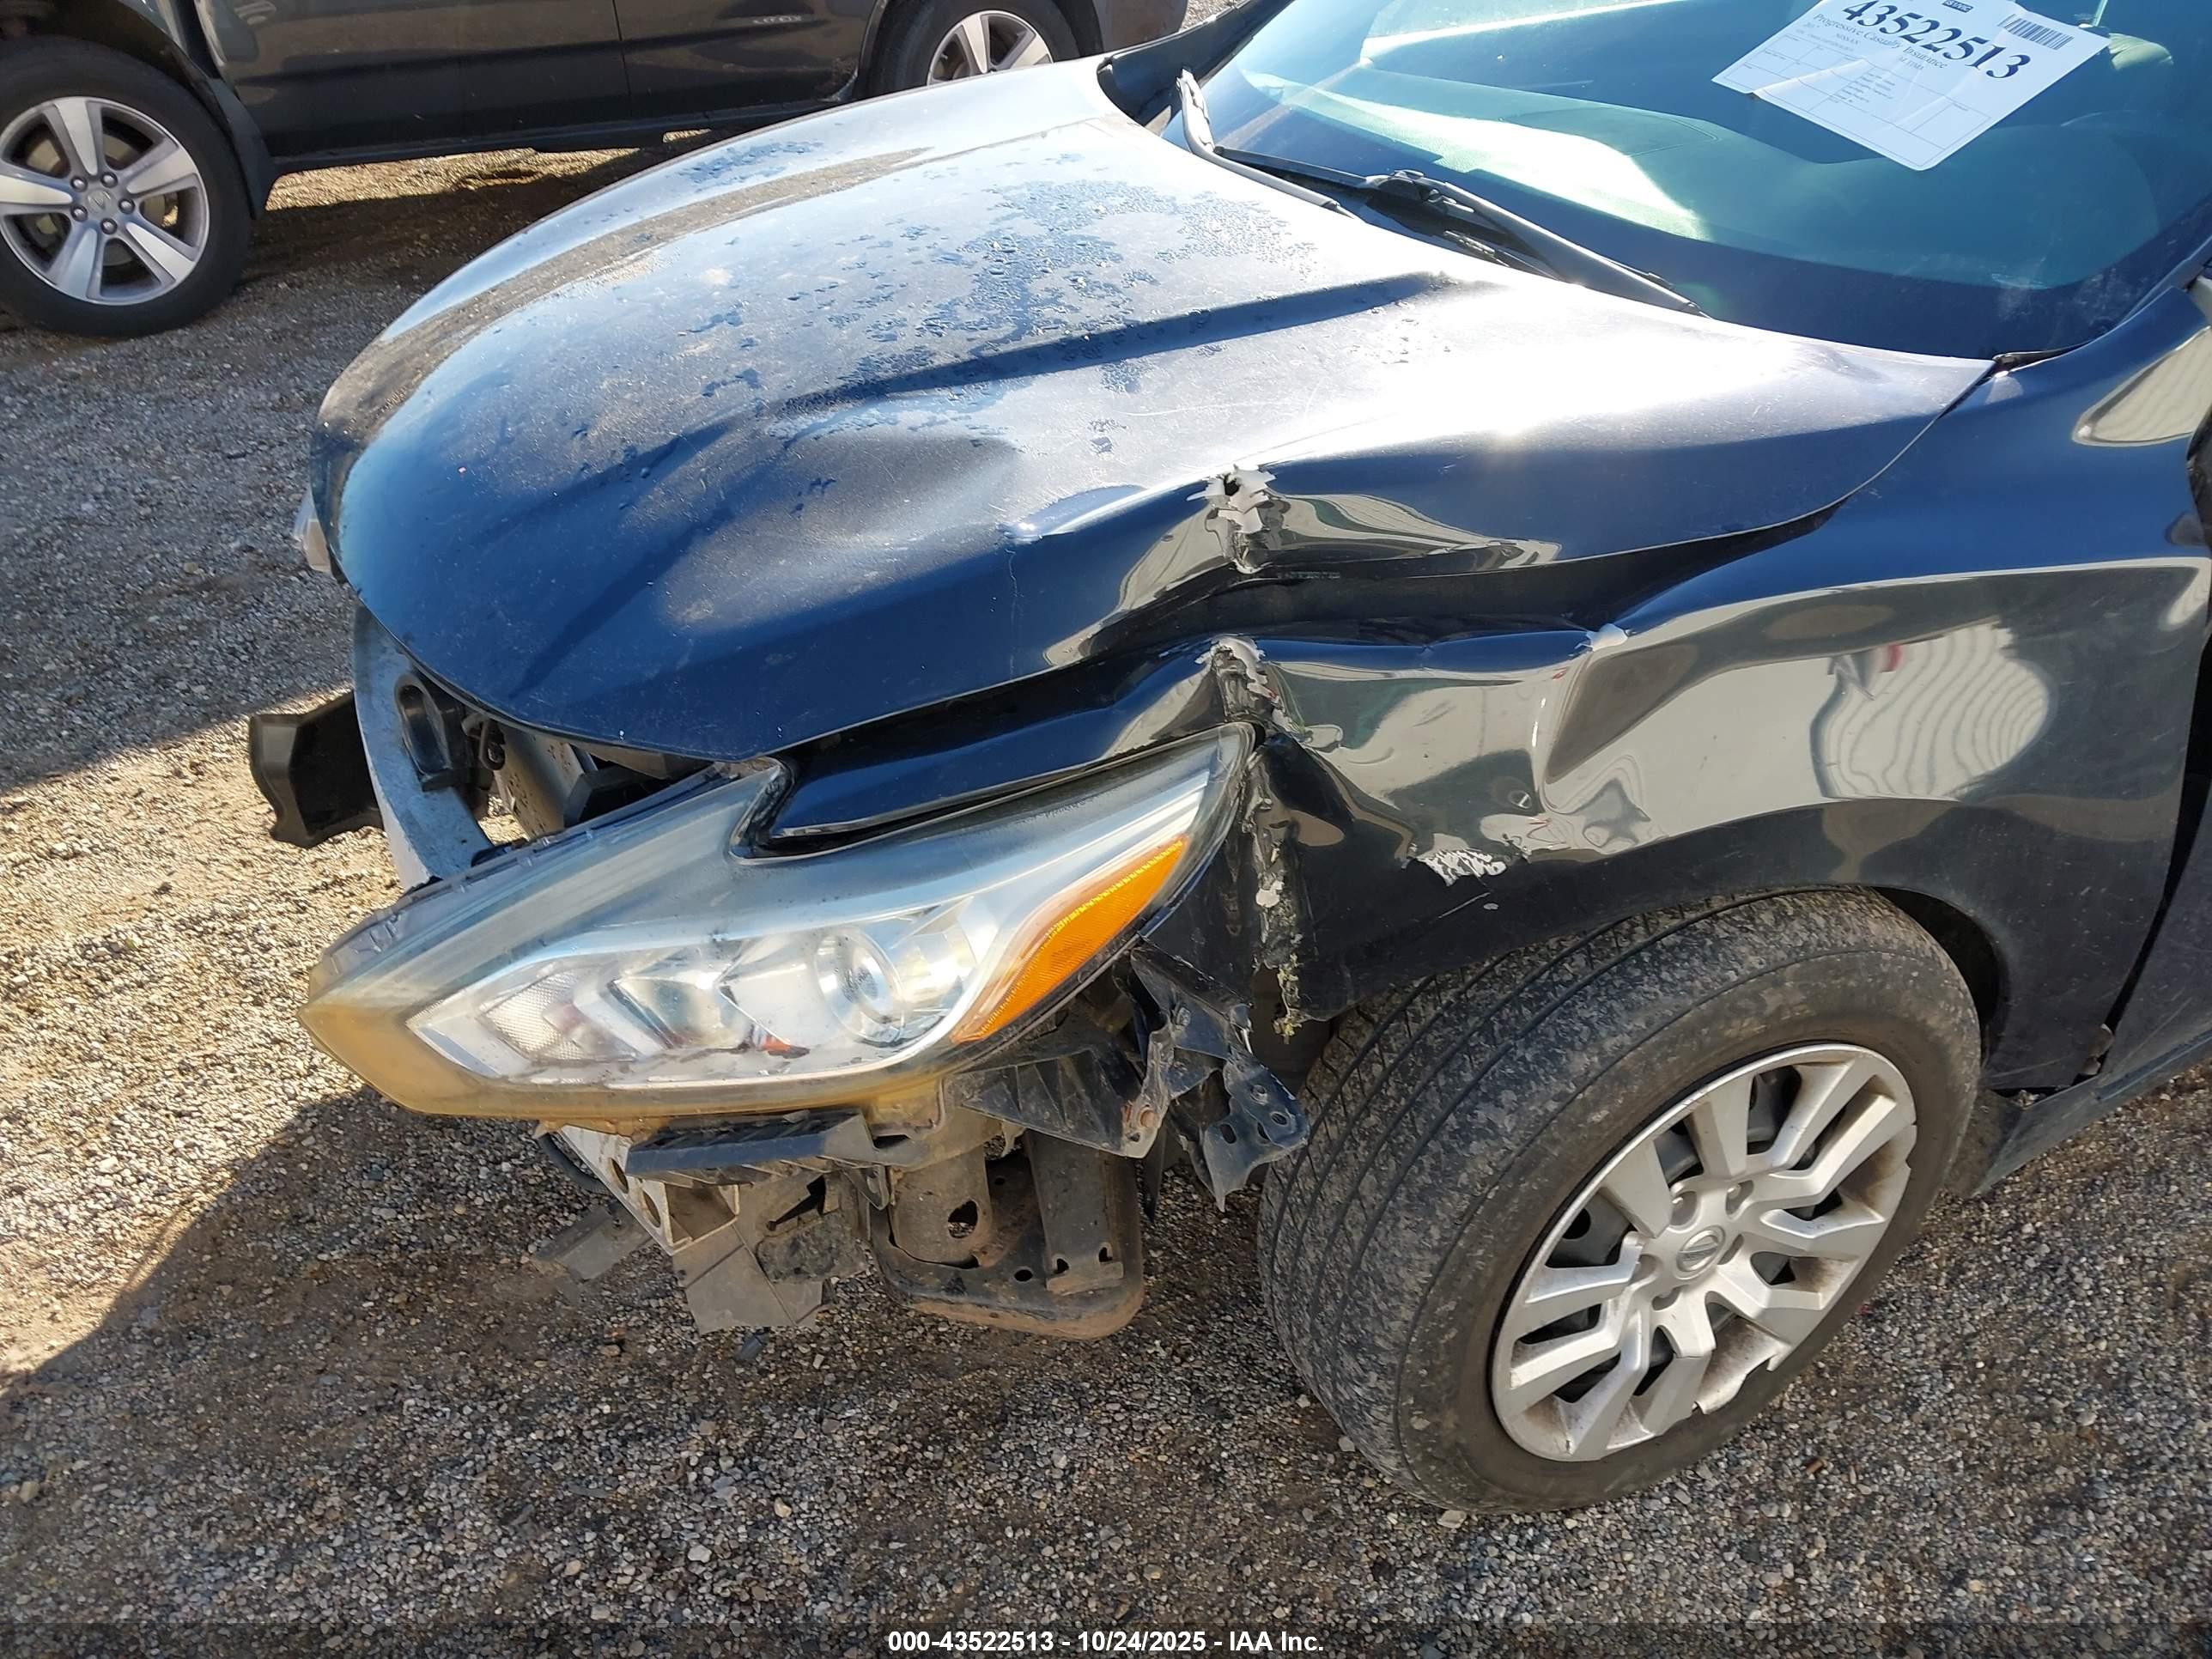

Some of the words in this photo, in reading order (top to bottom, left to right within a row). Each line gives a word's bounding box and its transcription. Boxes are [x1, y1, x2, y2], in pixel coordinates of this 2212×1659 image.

[1813, 14, 1863, 36] Progressive
[1863, 31, 1901, 49] Casualty
[1903, 46, 1948, 69] Insurance
[1842, 0, 2031, 79] 43522513
